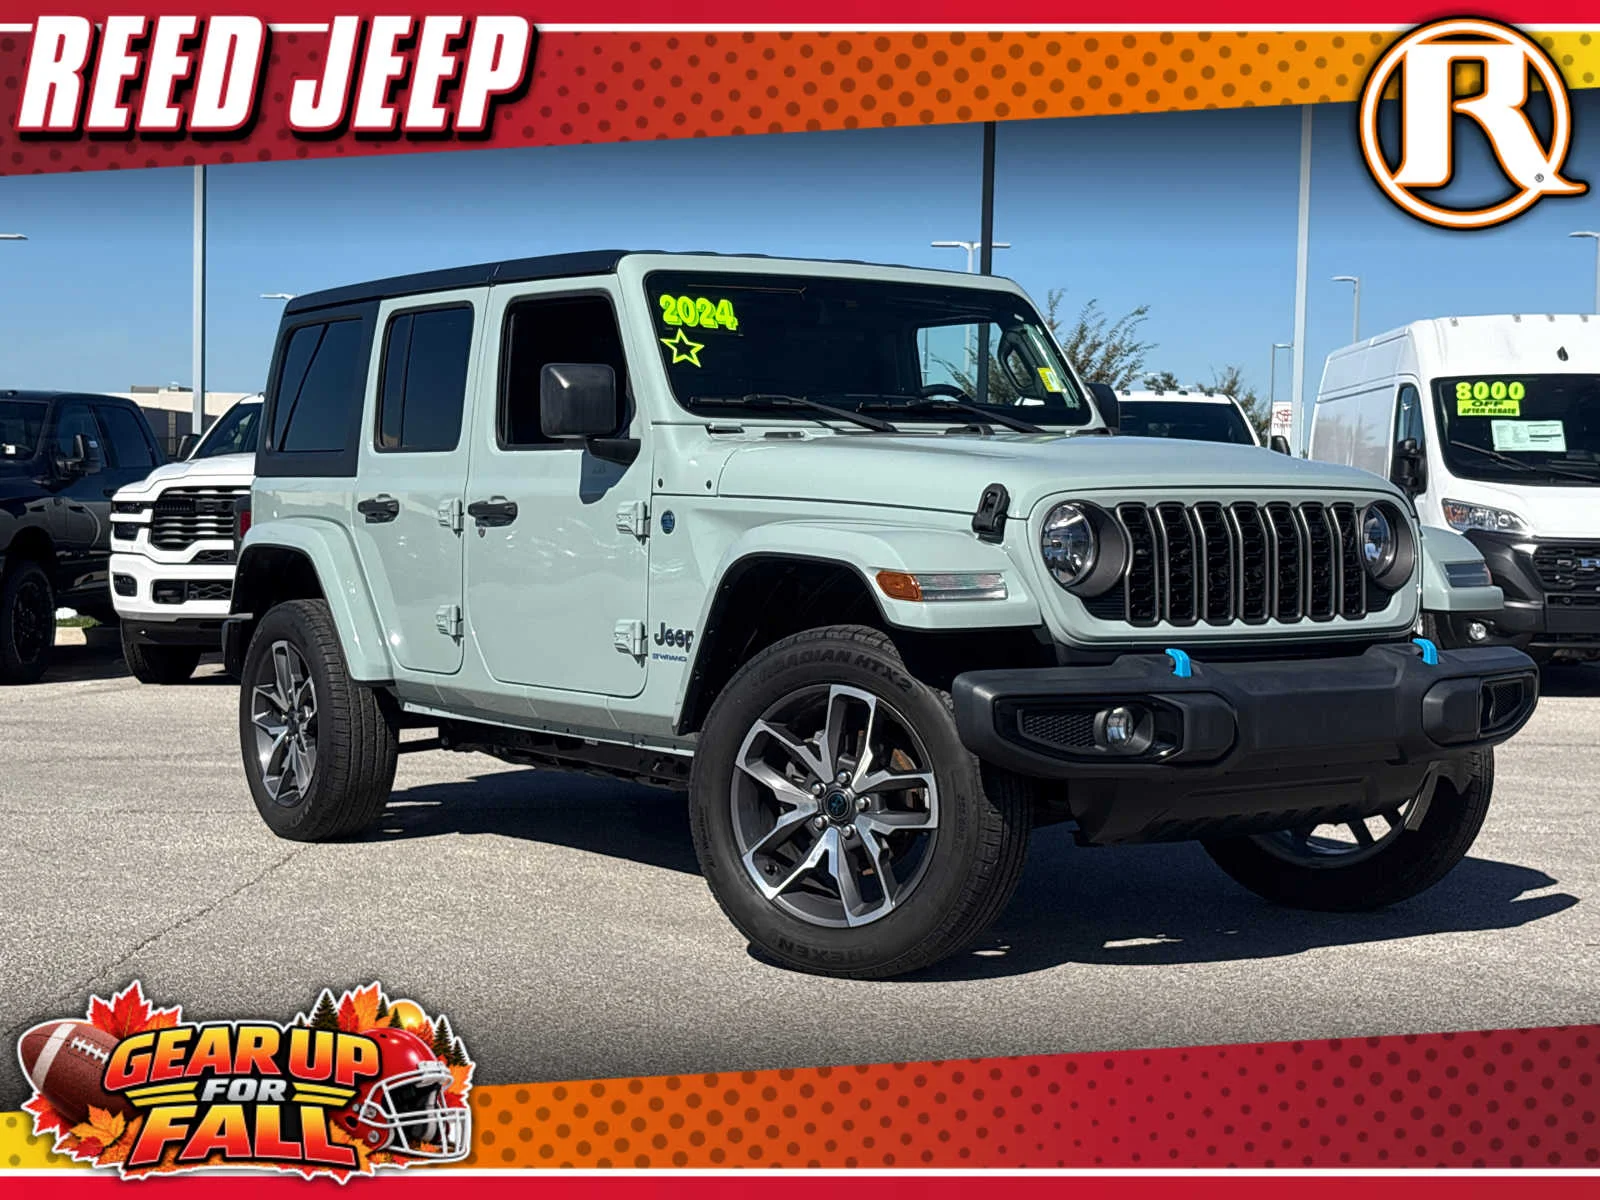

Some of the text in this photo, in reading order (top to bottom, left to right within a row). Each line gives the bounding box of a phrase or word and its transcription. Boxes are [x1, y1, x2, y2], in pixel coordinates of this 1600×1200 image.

[659, 293, 739, 331] 2024
[1455, 381, 1525, 400] 8000
[1461, 407, 1486, 415] AFTER
[653, 621, 695, 653] Jeep
